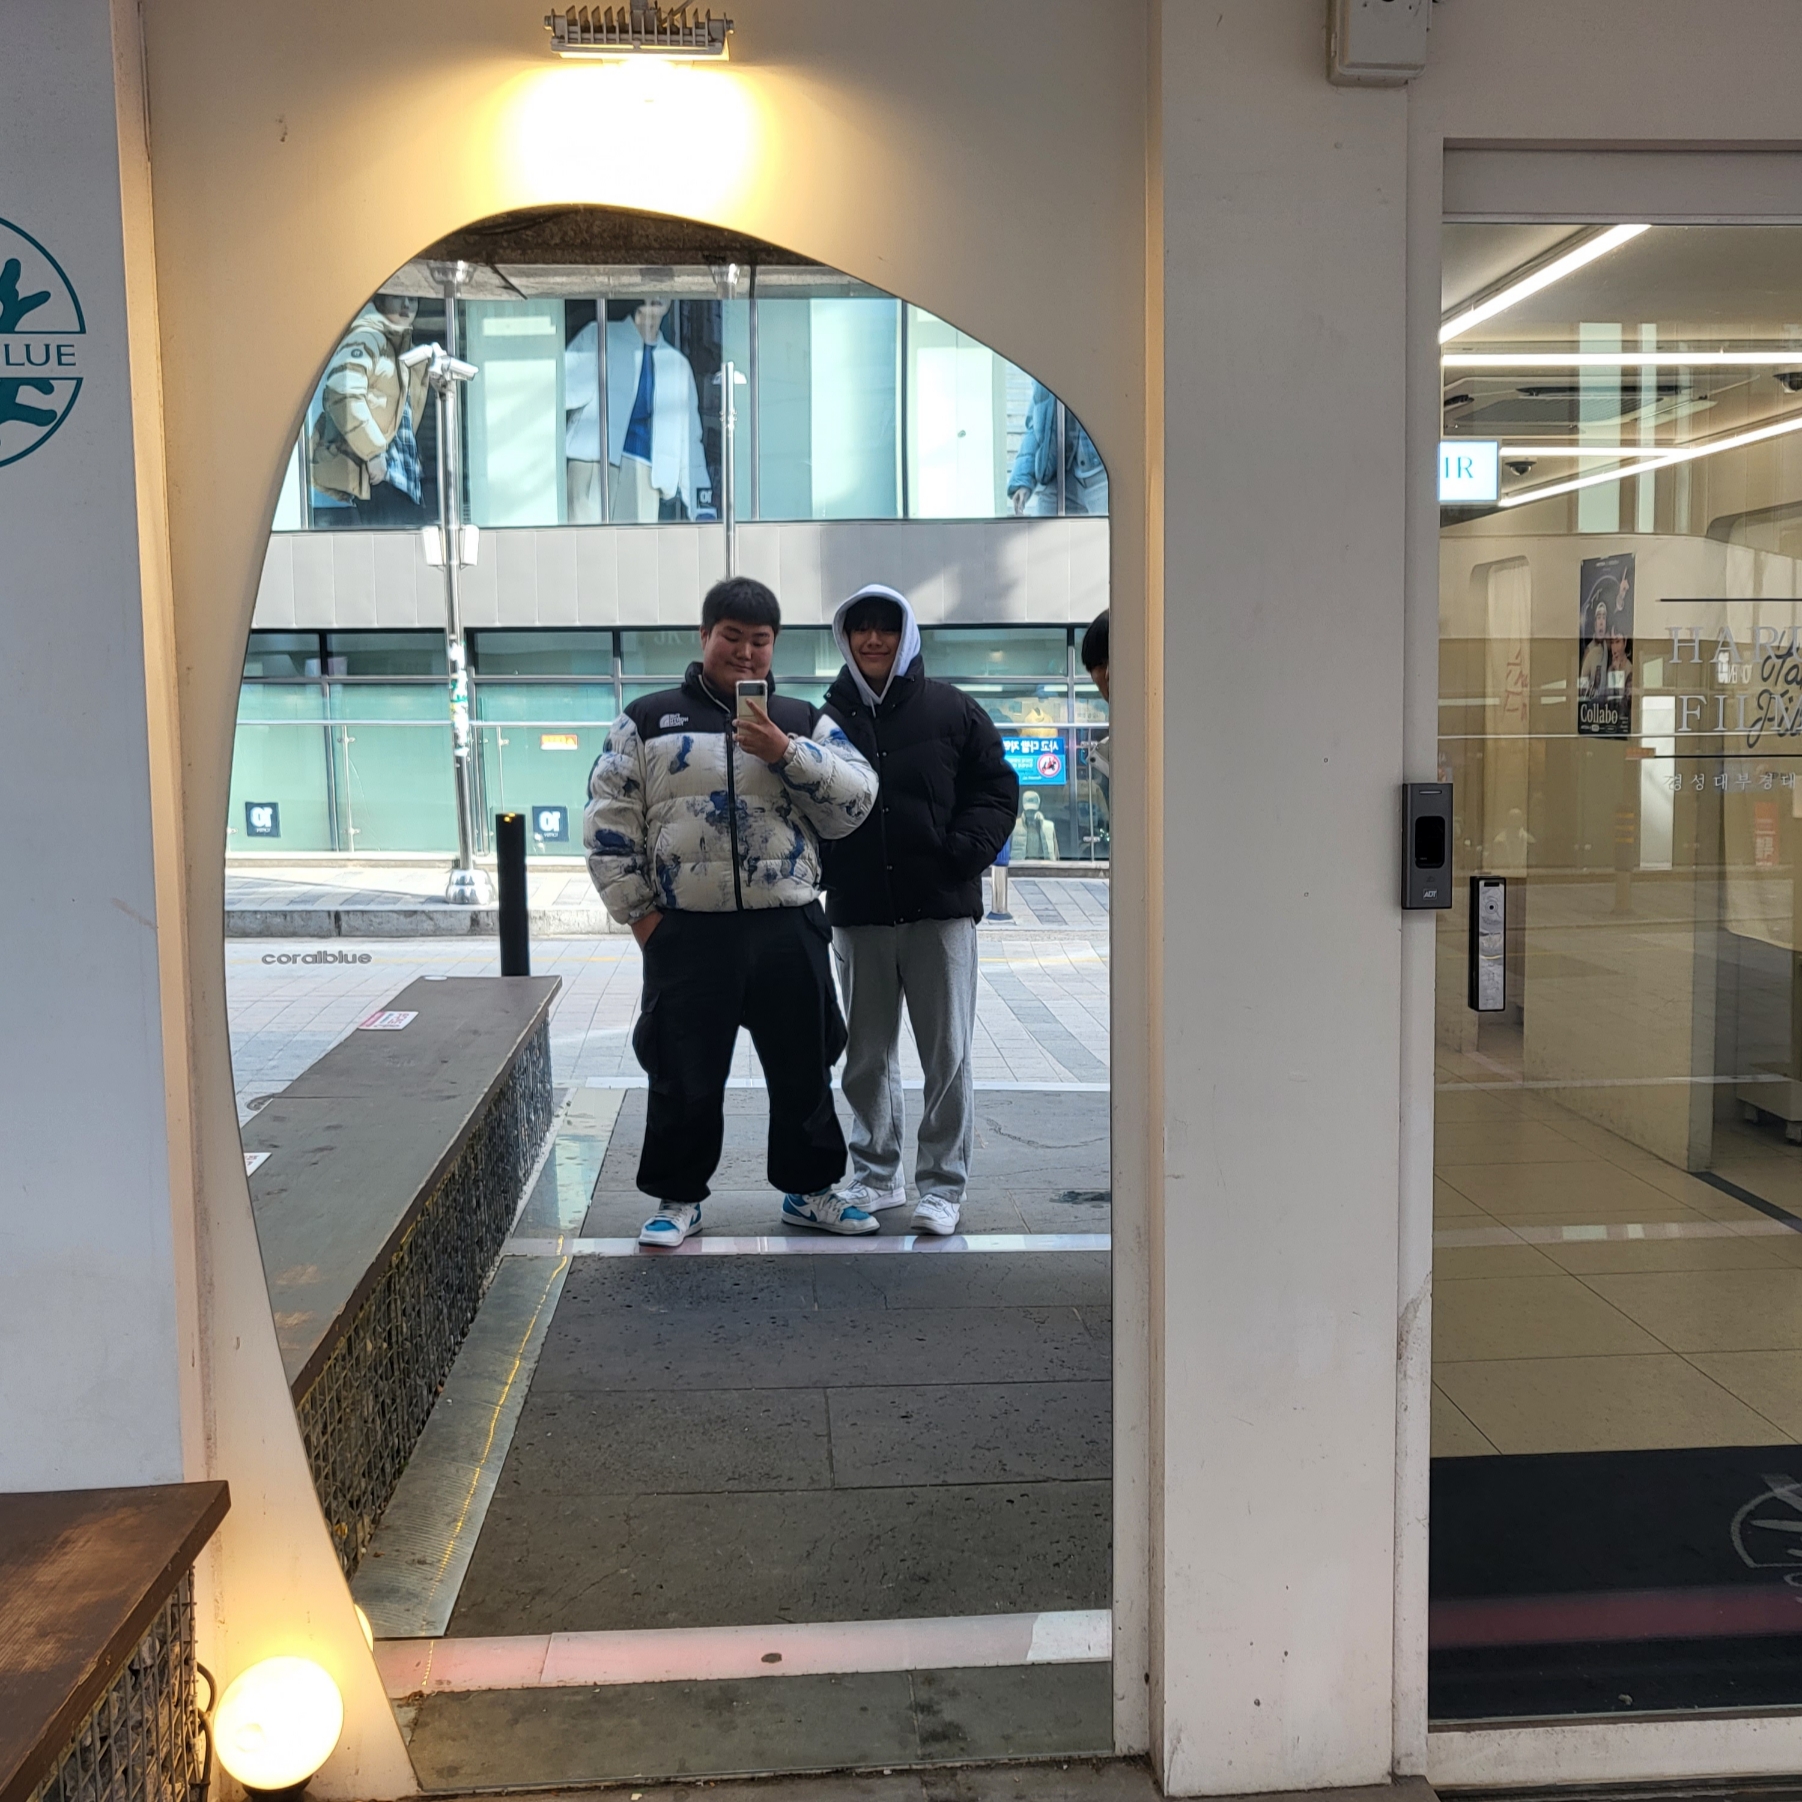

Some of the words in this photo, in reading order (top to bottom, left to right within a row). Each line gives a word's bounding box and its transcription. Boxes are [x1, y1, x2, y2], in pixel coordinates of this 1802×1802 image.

[1580, 703, 1618, 725] Collabo
[1423, 890, 1437, 898] ADT
[261, 950, 372, 965] coralblue
